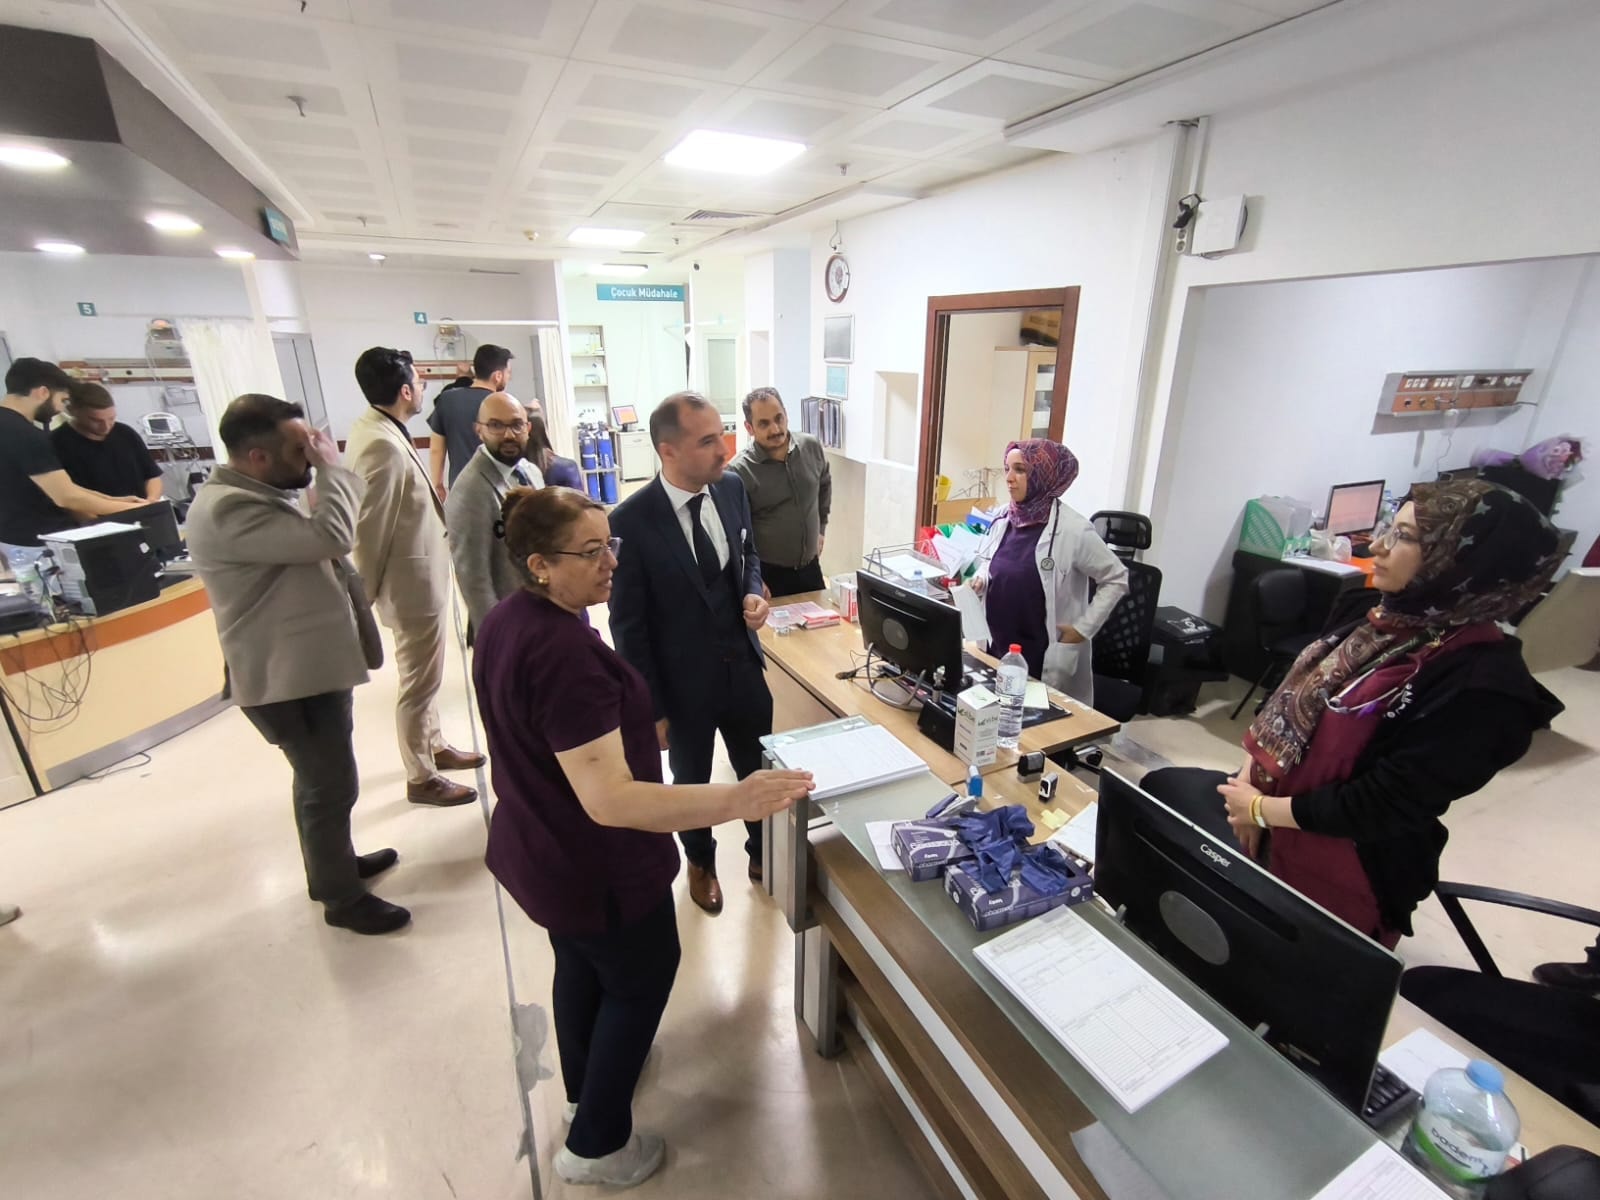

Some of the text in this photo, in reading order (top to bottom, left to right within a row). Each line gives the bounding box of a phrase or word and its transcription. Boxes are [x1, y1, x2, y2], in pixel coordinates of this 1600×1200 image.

[610, 286, 679, 299] Çocuk Müdahale
[82, 304, 92, 315] 5
[417, 313, 425, 322] 4
[1200, 843, 1231, 867] Casper
